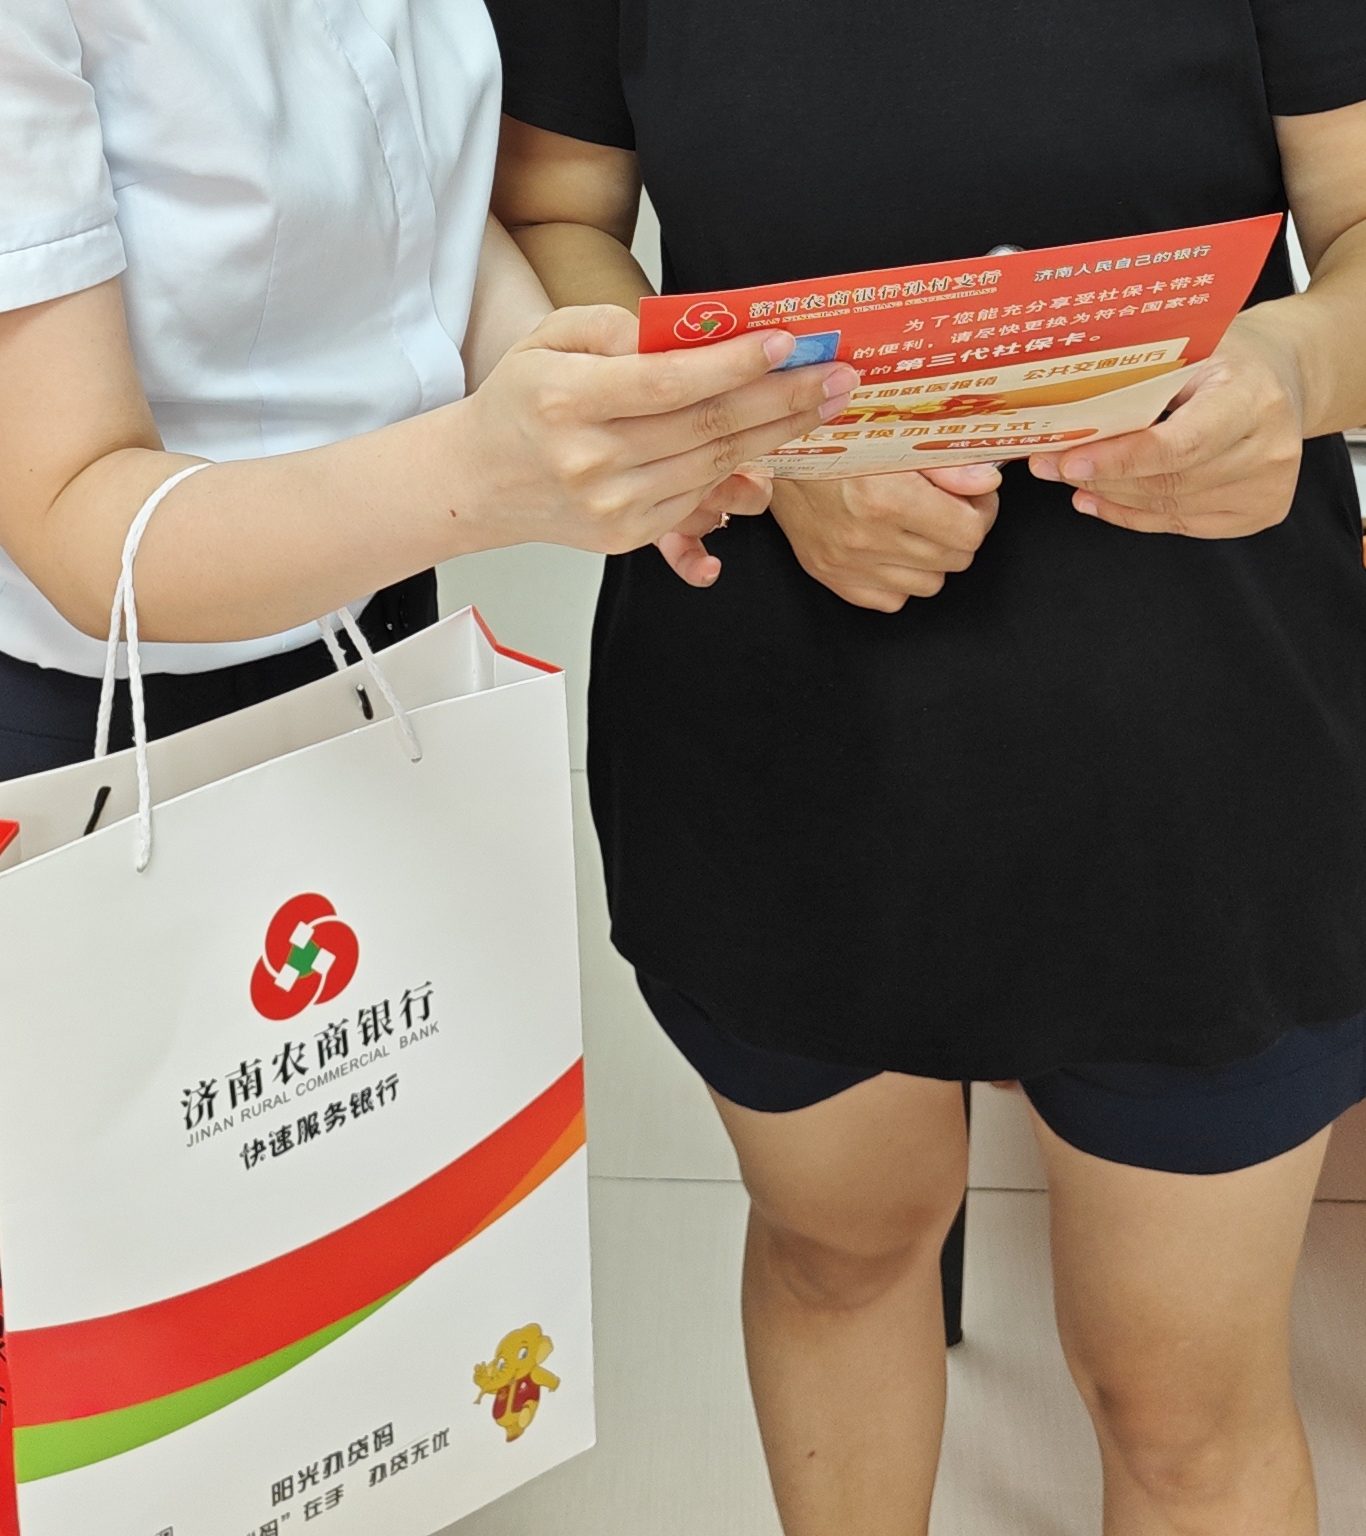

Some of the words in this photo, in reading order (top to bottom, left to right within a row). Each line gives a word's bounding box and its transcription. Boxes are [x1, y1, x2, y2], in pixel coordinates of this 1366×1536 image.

[748, 269, 1002, 318] 济南农商银行孙村支行
[1033, 245, 1211, 283] 济南人民自己的银行
[902, 273, 1216, 333] 为了您能充分享受社保卡带来
[1022, 349, 1168, 381] 公共交通出行
[180, 980, 434, 1130] 济南农商银行
[186, 1115, 235, 1148] JINAN
[240, 1090, 292, 1122] RURAL
[295, 1045, 390, 1097] COMMERCIAL
[399, 1020, 440, 1049] BANK
[238, 1073, 400, 1171] 快速服务银行
[271, 1421, 394, 1507] 阳光办贷码
[368, 1427, 450, 1487] 办贷无忧
